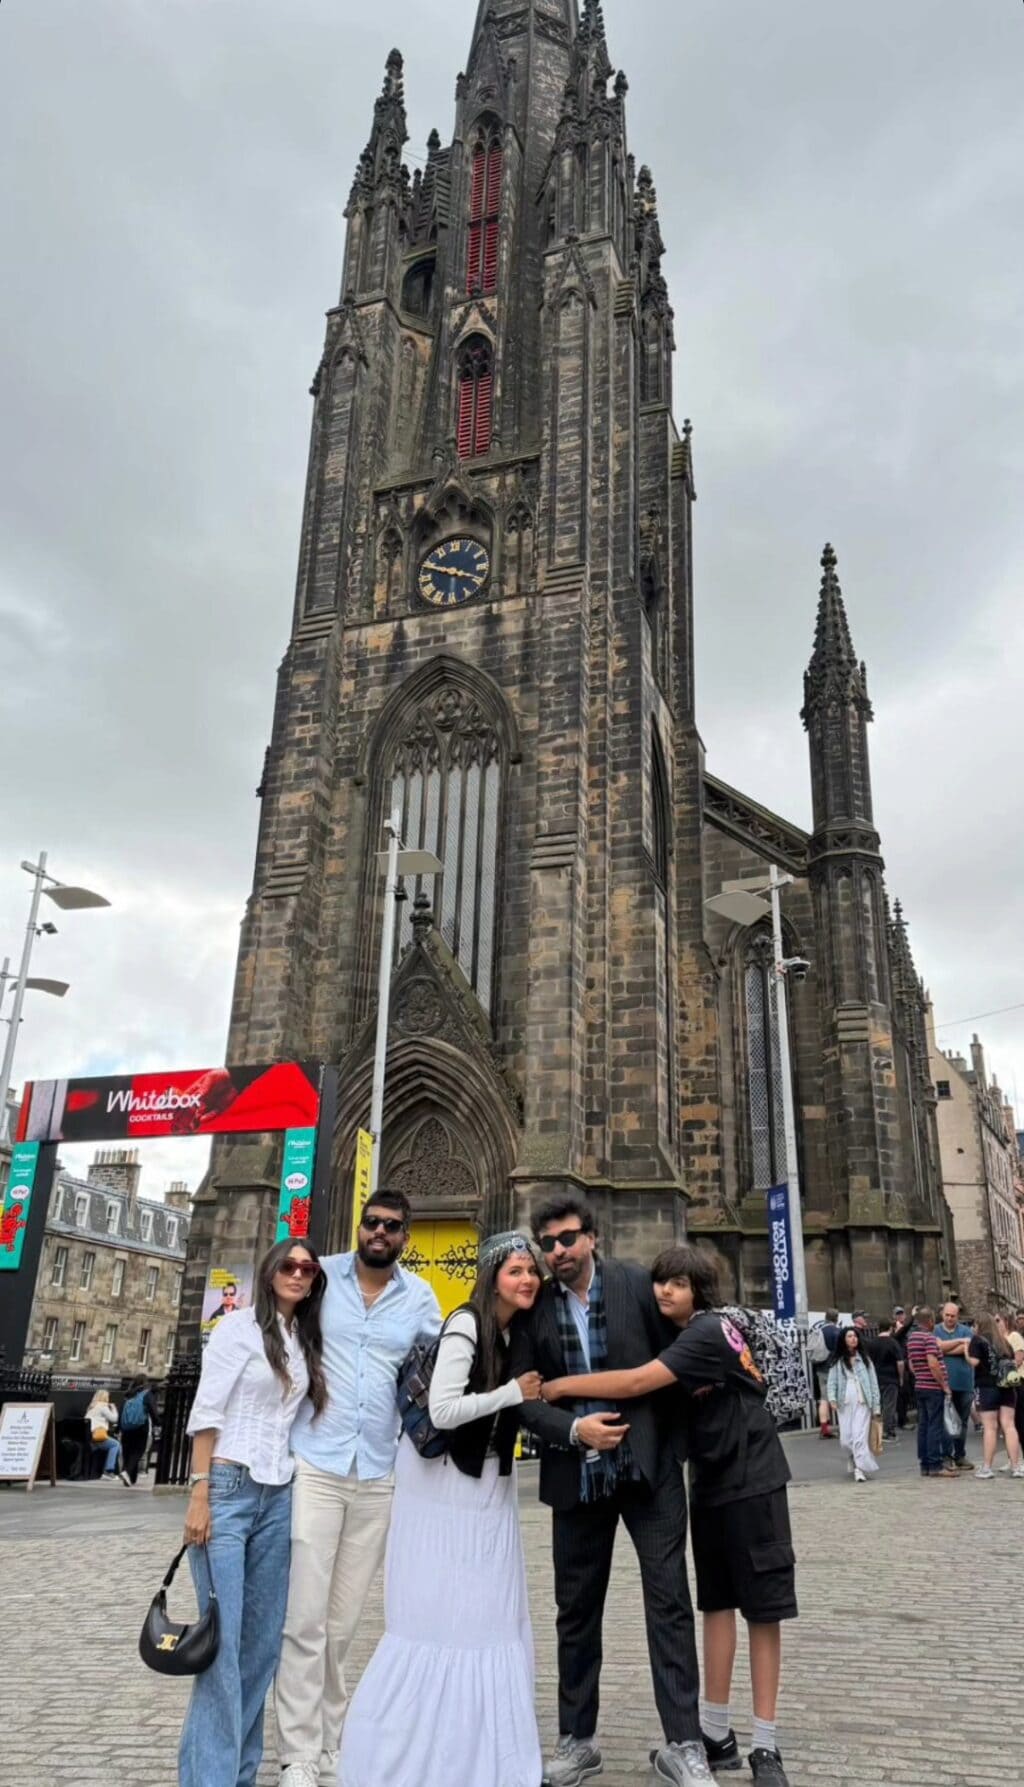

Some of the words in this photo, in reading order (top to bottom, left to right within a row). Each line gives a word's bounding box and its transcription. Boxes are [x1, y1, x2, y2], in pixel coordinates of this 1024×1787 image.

[106, 1087, 201, 1113] Whitebox
[779, 1218, 789, 1281] TATTOO
[773, 1254, 785, 1310] OFFICE
